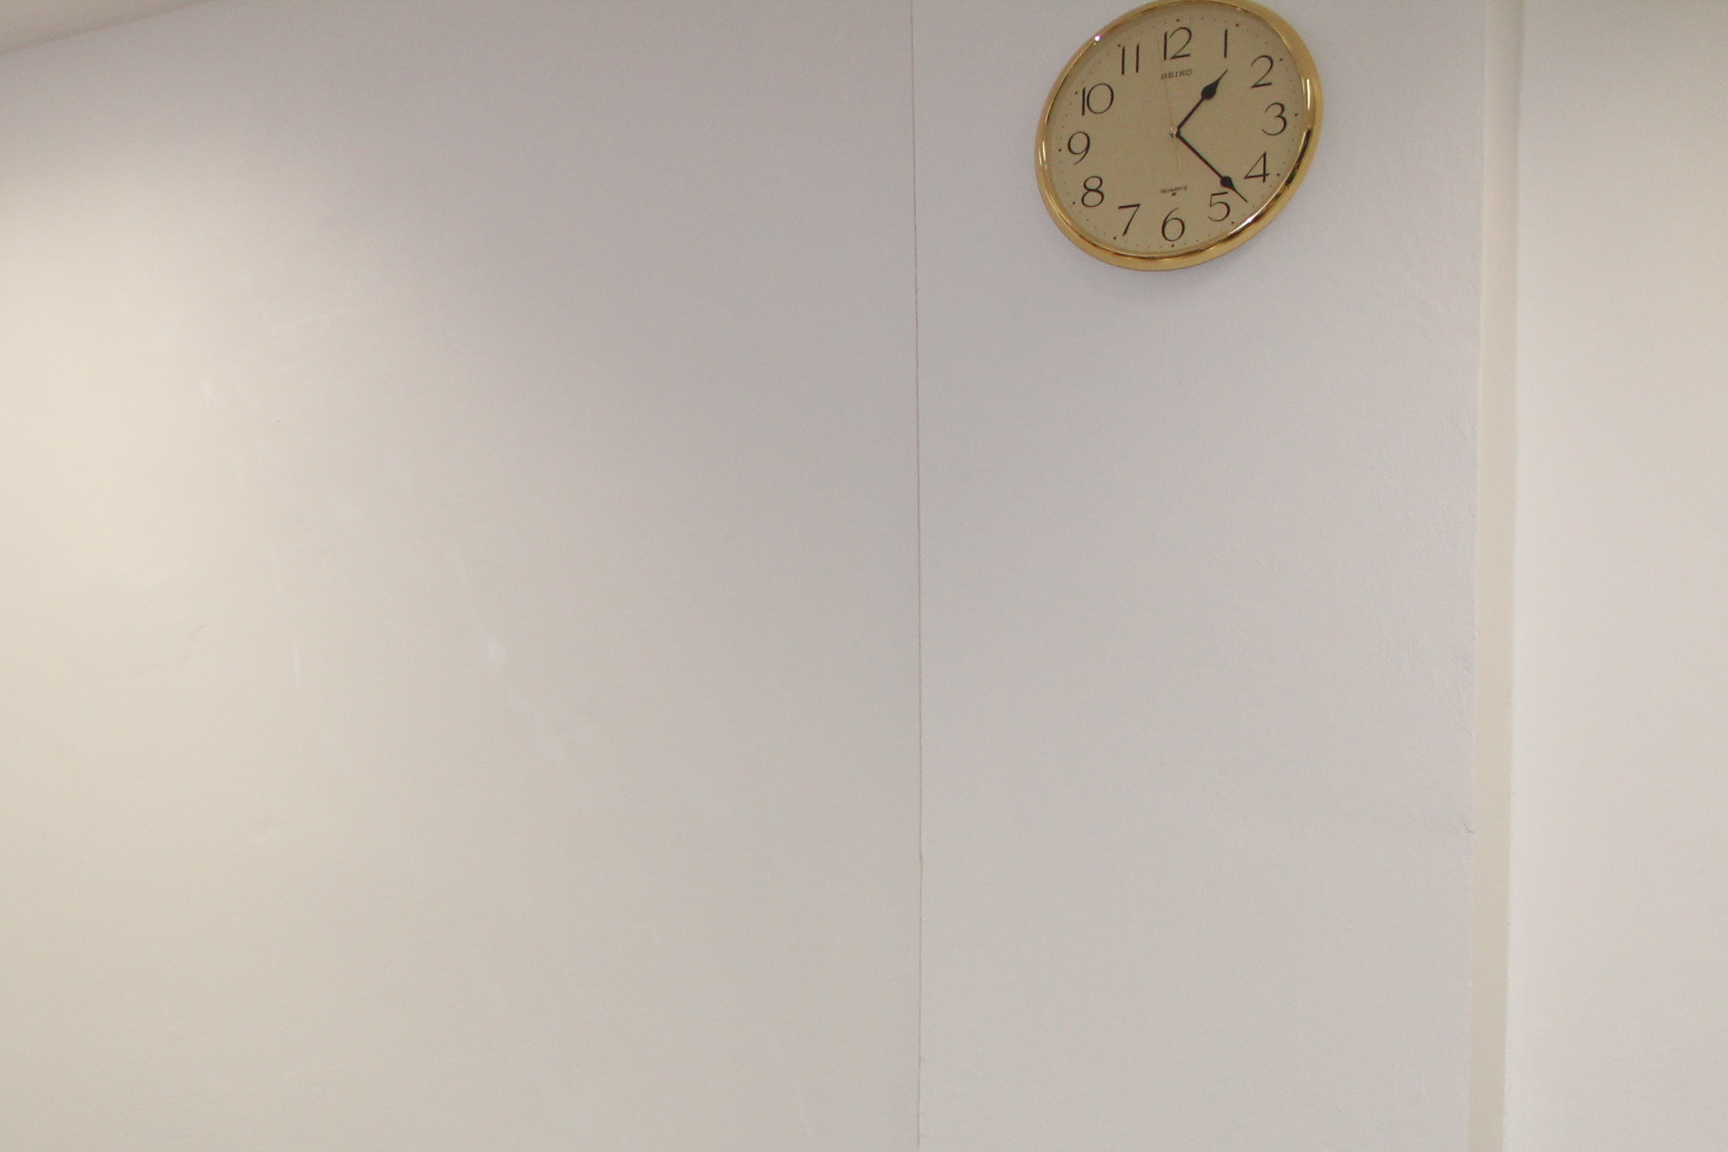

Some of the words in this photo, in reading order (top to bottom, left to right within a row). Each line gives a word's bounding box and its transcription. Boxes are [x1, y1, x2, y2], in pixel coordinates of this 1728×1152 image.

[1121, 44, 1140, 75] 11
[1163, 27, 1192, 60] 12
[1223, 28, 1229, 58] 1
[1250, 55, 1274, 88] 2
[1081, 83, 1114, 116] 10
[1262, 102, 1287, 136] 3
[1067, 131, 1091, 165] 9
[1244, 151, 1270, 183] 4
[1081, 175, 1105, 207] 8
[1208, 191, 1231, 222] 5
[1118, 203, 1141, 236] 7
[1161, 207, 1185, 242] 6
